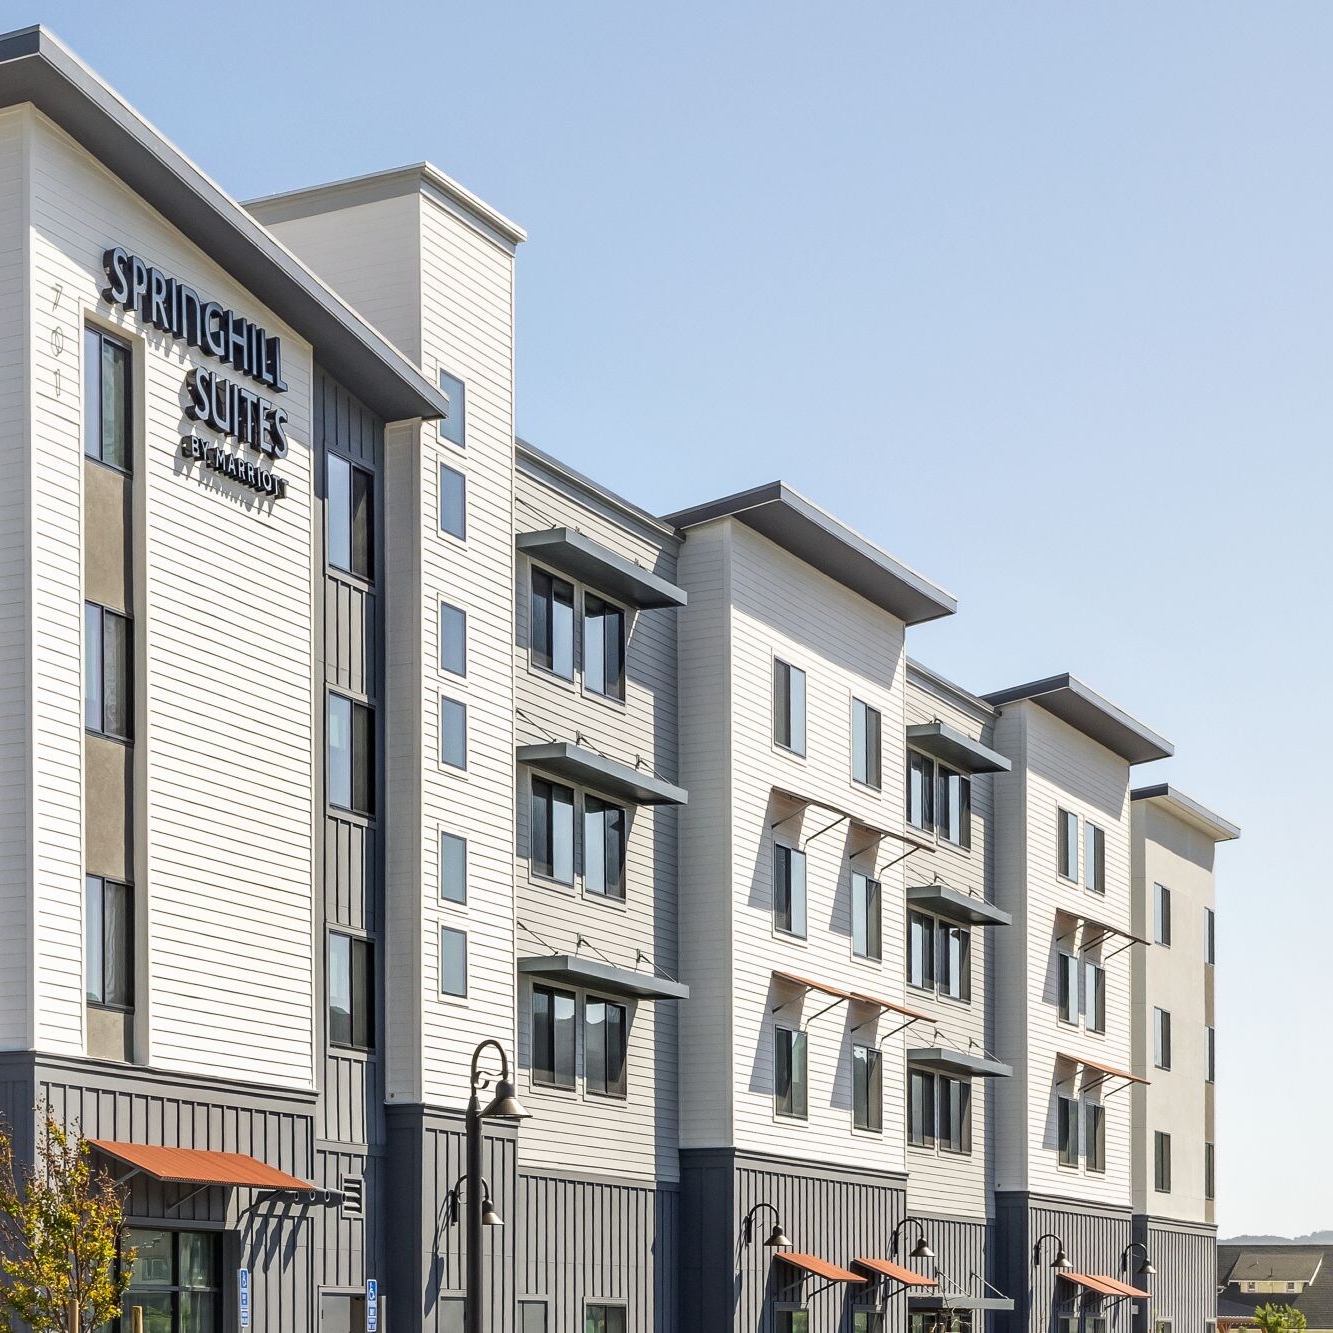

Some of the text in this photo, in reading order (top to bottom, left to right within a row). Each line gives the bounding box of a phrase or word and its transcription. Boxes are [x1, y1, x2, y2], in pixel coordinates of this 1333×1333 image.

[102, 247, 288, 392] SPRINGHILL
[183, 435, 210, 461] BY
[185, 366, 288, 459] SUITES
